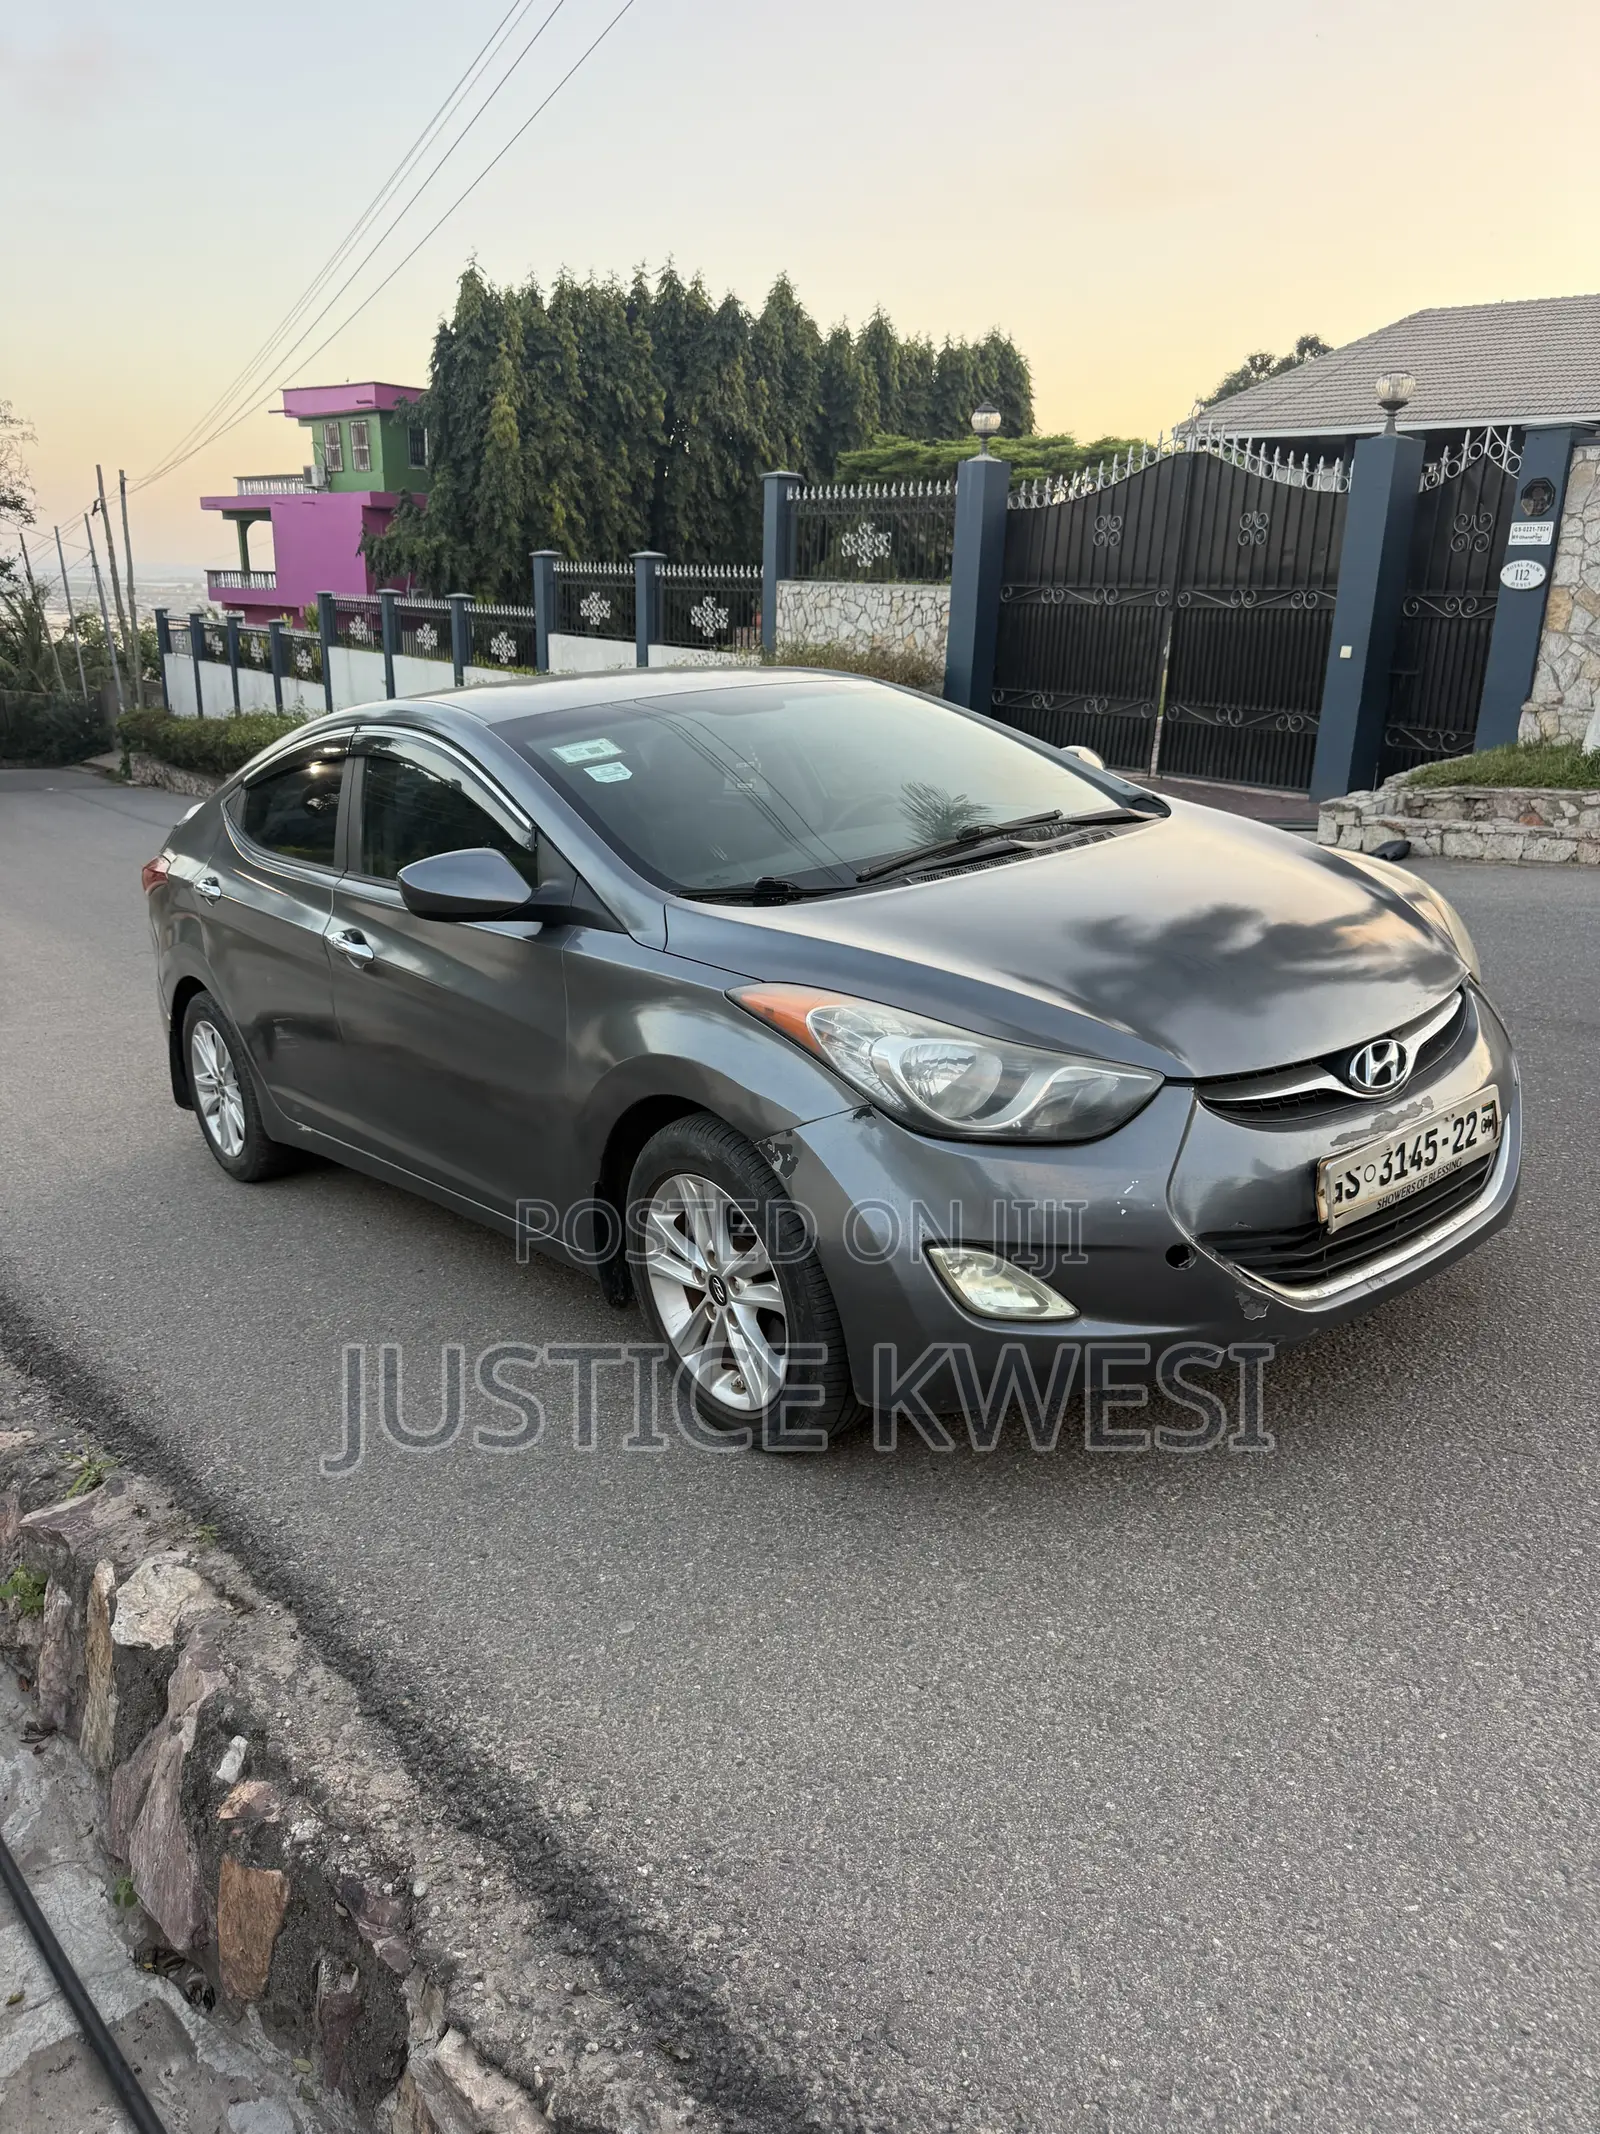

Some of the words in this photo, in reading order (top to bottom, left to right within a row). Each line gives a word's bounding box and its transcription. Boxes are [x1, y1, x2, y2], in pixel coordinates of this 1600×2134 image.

[1515, 569, 1530, 580] 112
[1525, 562, 1541, 572] PALM
[1378, 1110, 1478, 1187] 3145-22
[1376, 1182, 1416, 1210] SHOWERS
[1417, 1175, 1428, 1190] OF
[1428, 1157, 1463, 1183] BLESSING
